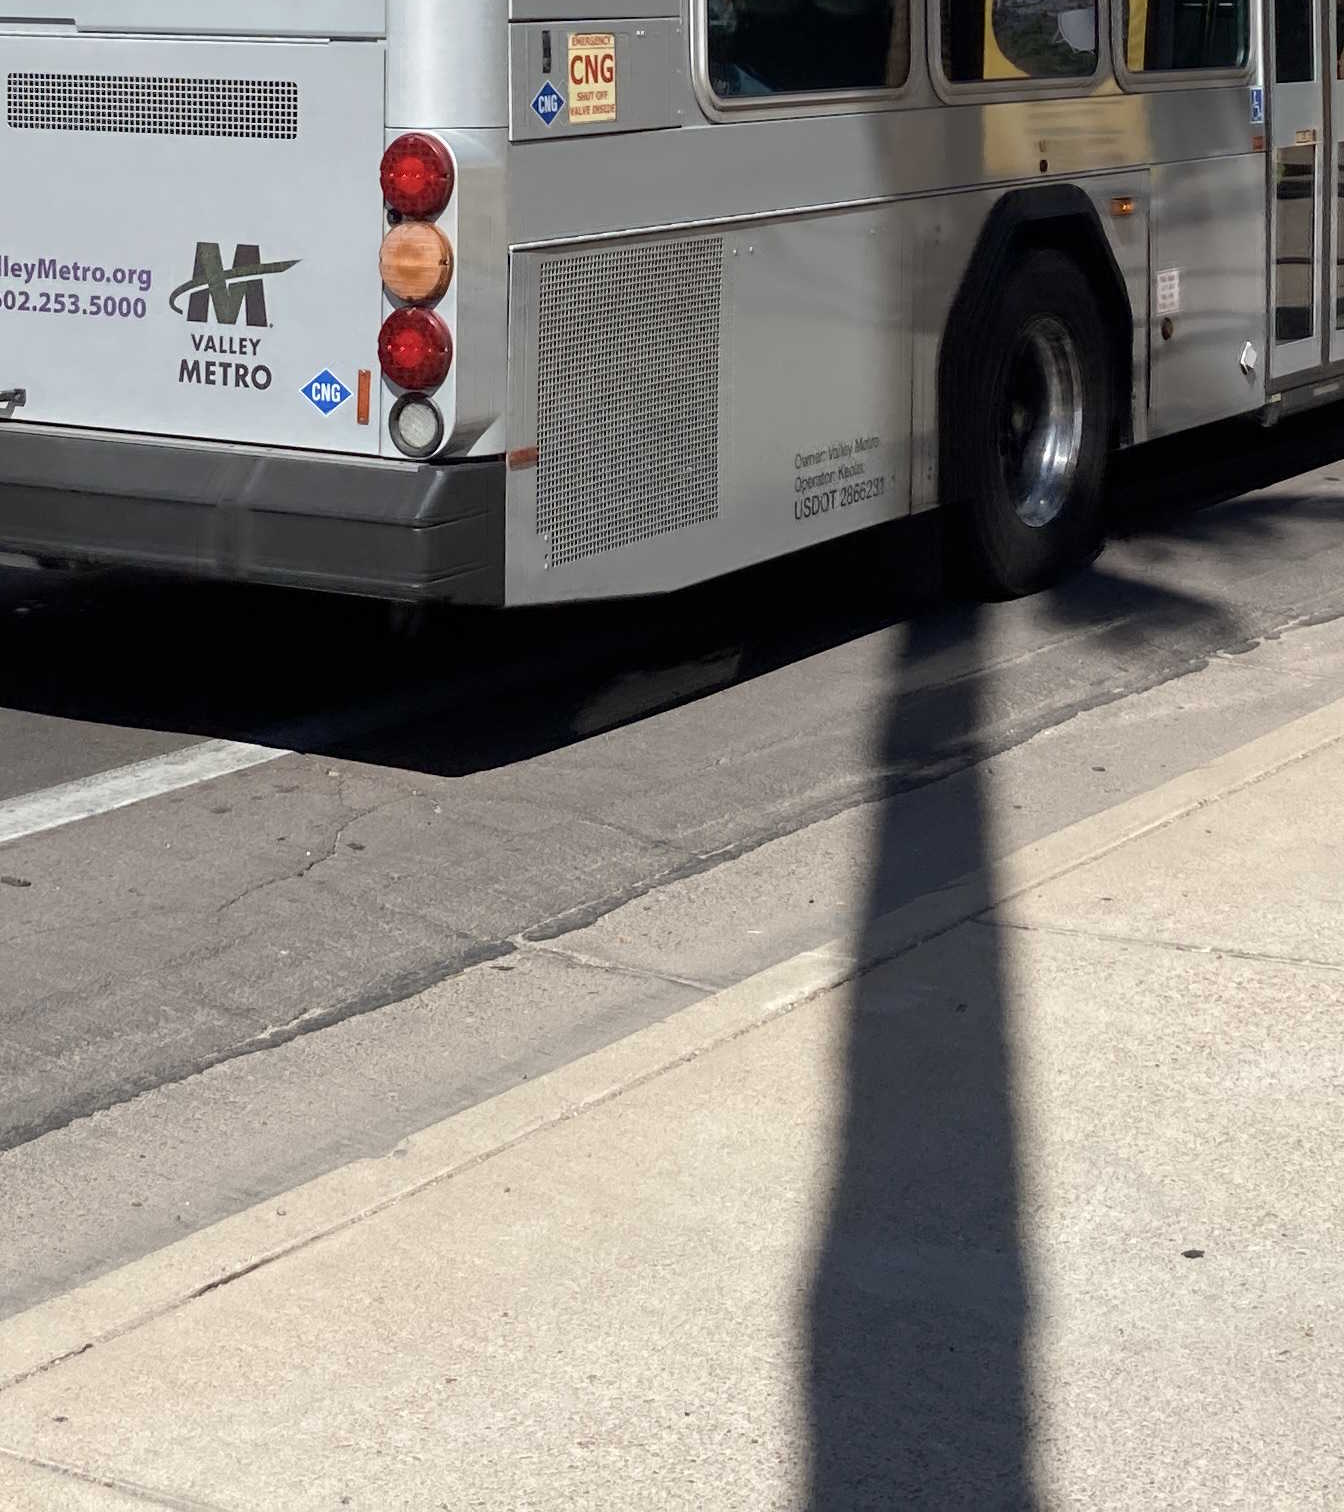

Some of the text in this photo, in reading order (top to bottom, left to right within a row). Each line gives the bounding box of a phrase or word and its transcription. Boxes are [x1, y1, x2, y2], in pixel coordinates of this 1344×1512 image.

[570, 54, 614, 85] CNG
[537, 94, 558, 114] CNG
[190, 334, 262, 356] VALLEY
[178, 358, 273, 391] METRO
[311, 382, 341, 403] CNG
[794, 490, 837, 520] USDOT
